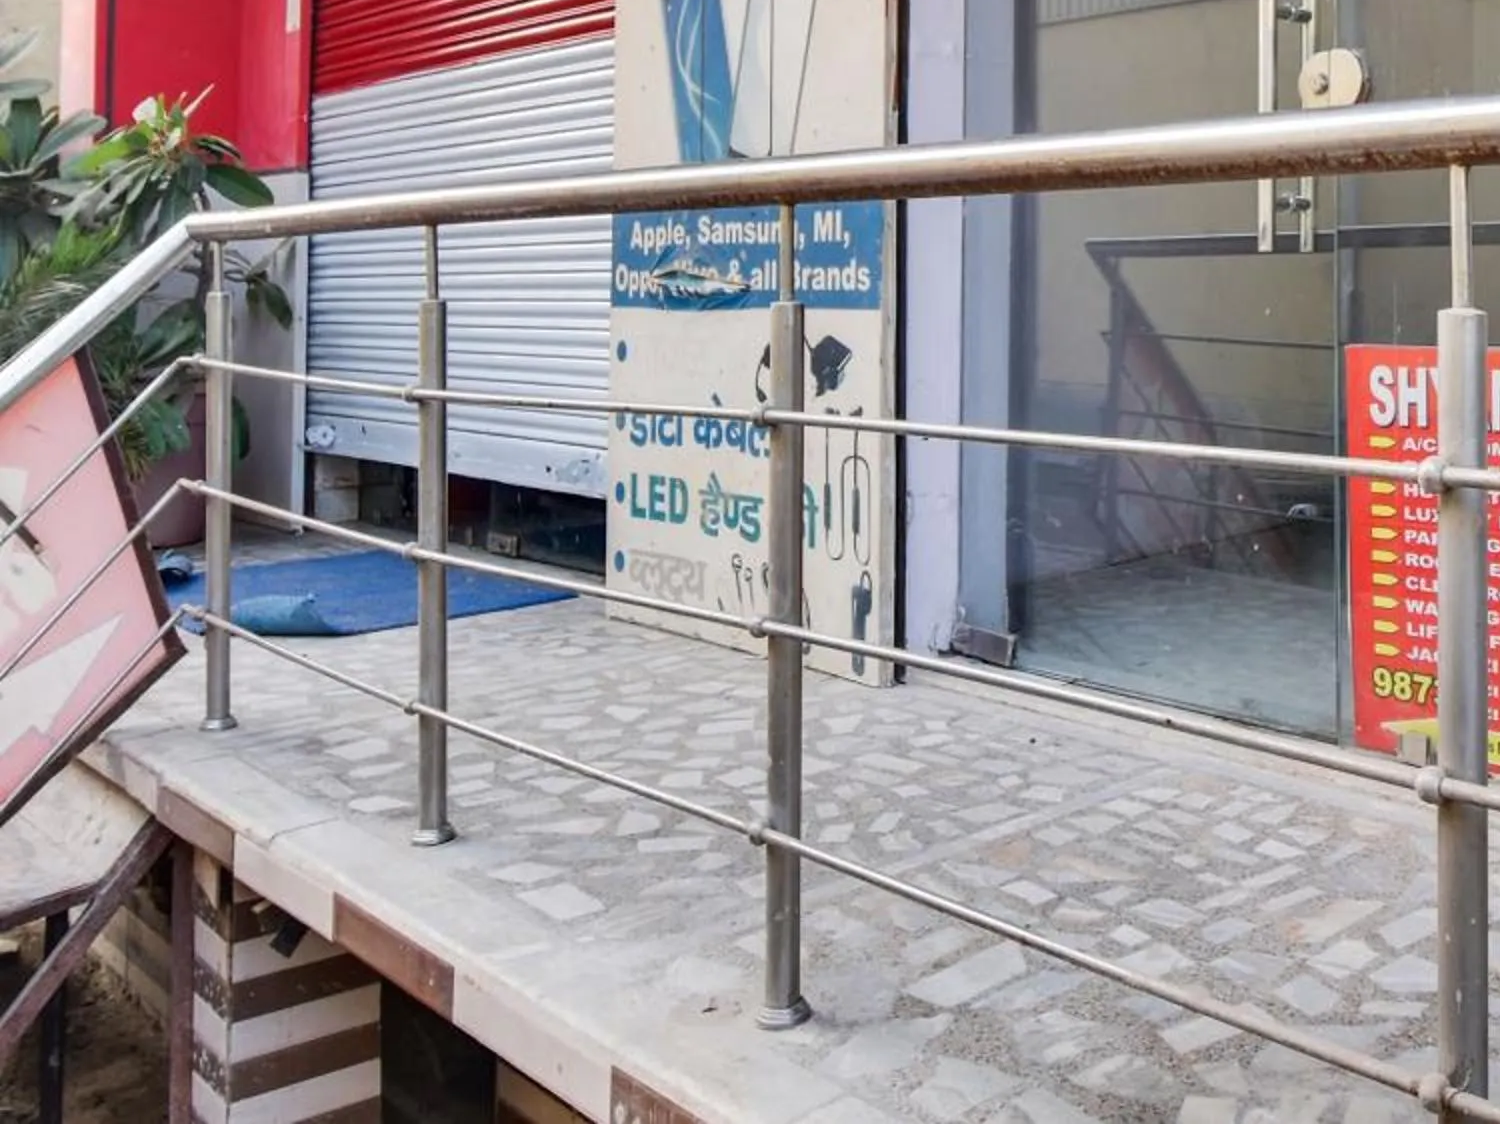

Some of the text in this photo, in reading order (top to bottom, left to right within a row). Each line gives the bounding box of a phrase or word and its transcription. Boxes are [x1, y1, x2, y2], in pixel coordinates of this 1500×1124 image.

[630, 218, 691, 255] Apple,
[697, 216, 805, 249] Samsun,
[750, 260, 778, 292] all
[630, 473, 689, 524] LED
[1406, 622, 1439, 639] LIF
